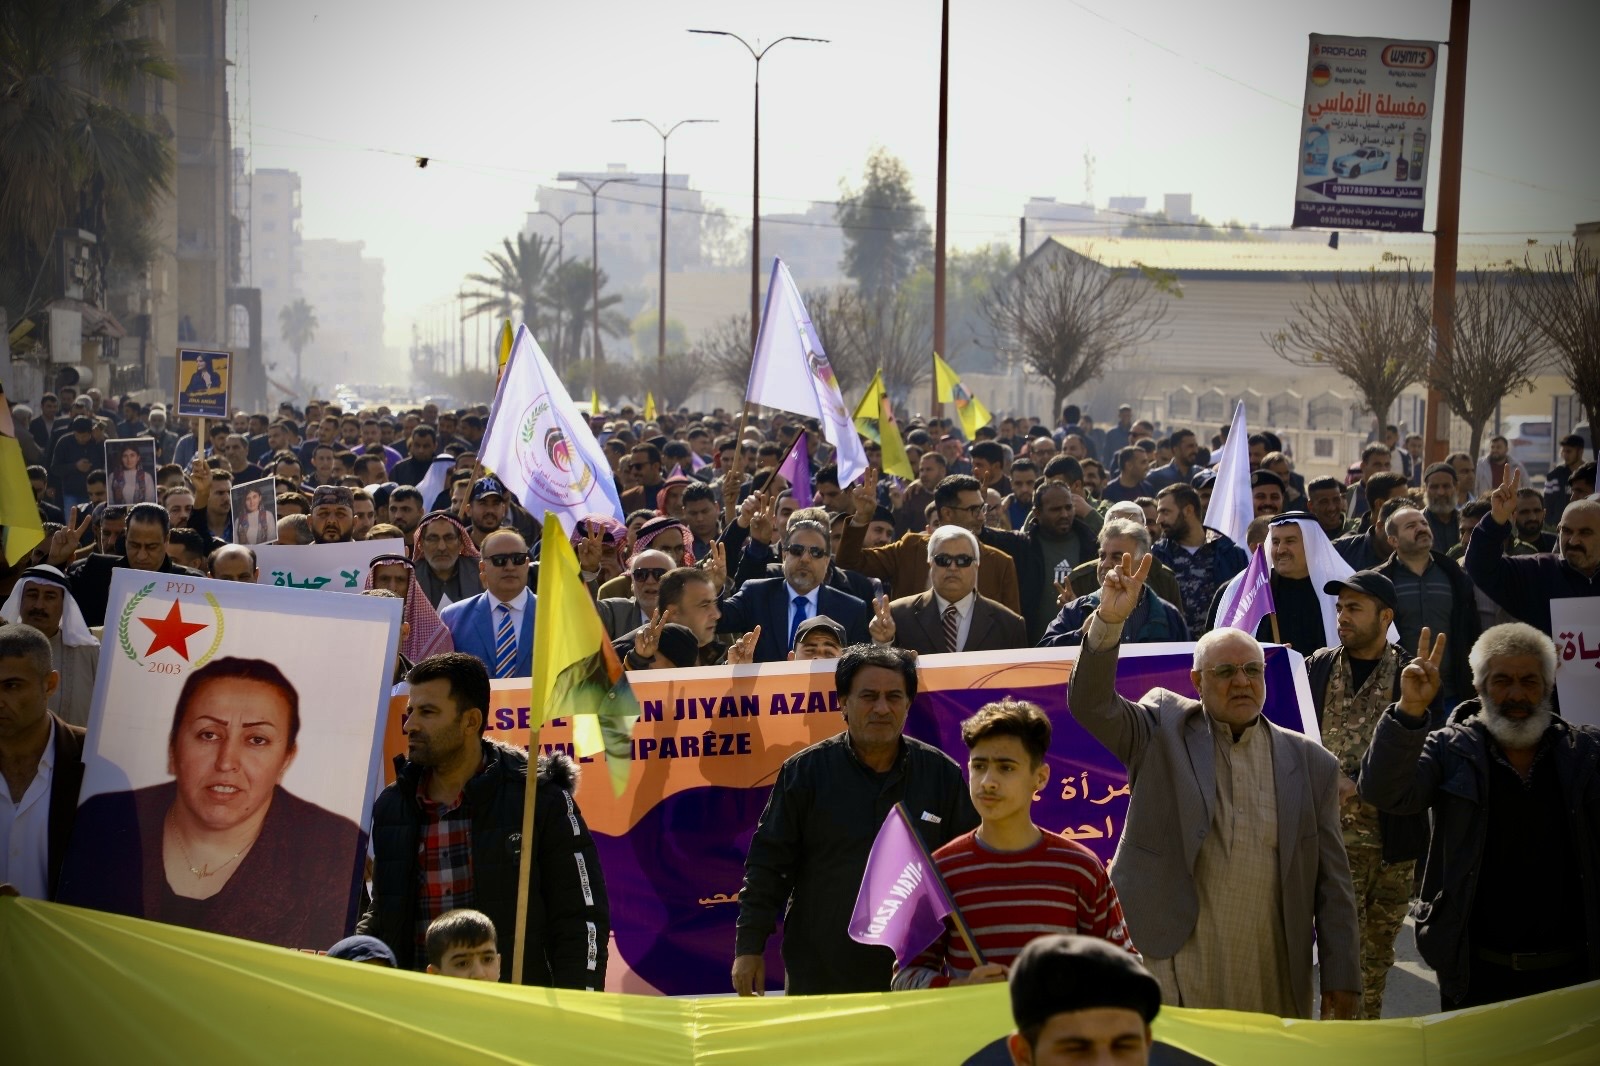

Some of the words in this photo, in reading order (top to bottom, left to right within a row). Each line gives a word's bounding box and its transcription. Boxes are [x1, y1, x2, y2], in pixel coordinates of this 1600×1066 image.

[1321, 46, 1367, 57] PROFI-CAR
[1375, 94, 1427, 118] مغسلة
[165, 581, 196, 595] PYD
[271, 571, 332, 590] حياة
[340, 569, 361, 588] لا
[148, 661, 182, 675] 2003
[637, 700, 664, 723] IN
[673, 694, 760, 722] JIYAN
[769, 690, 842, 716] AZAD
[605, 729, 752, 762] IPARÊZE
[1060, 771, 1131, 805] مرأة
